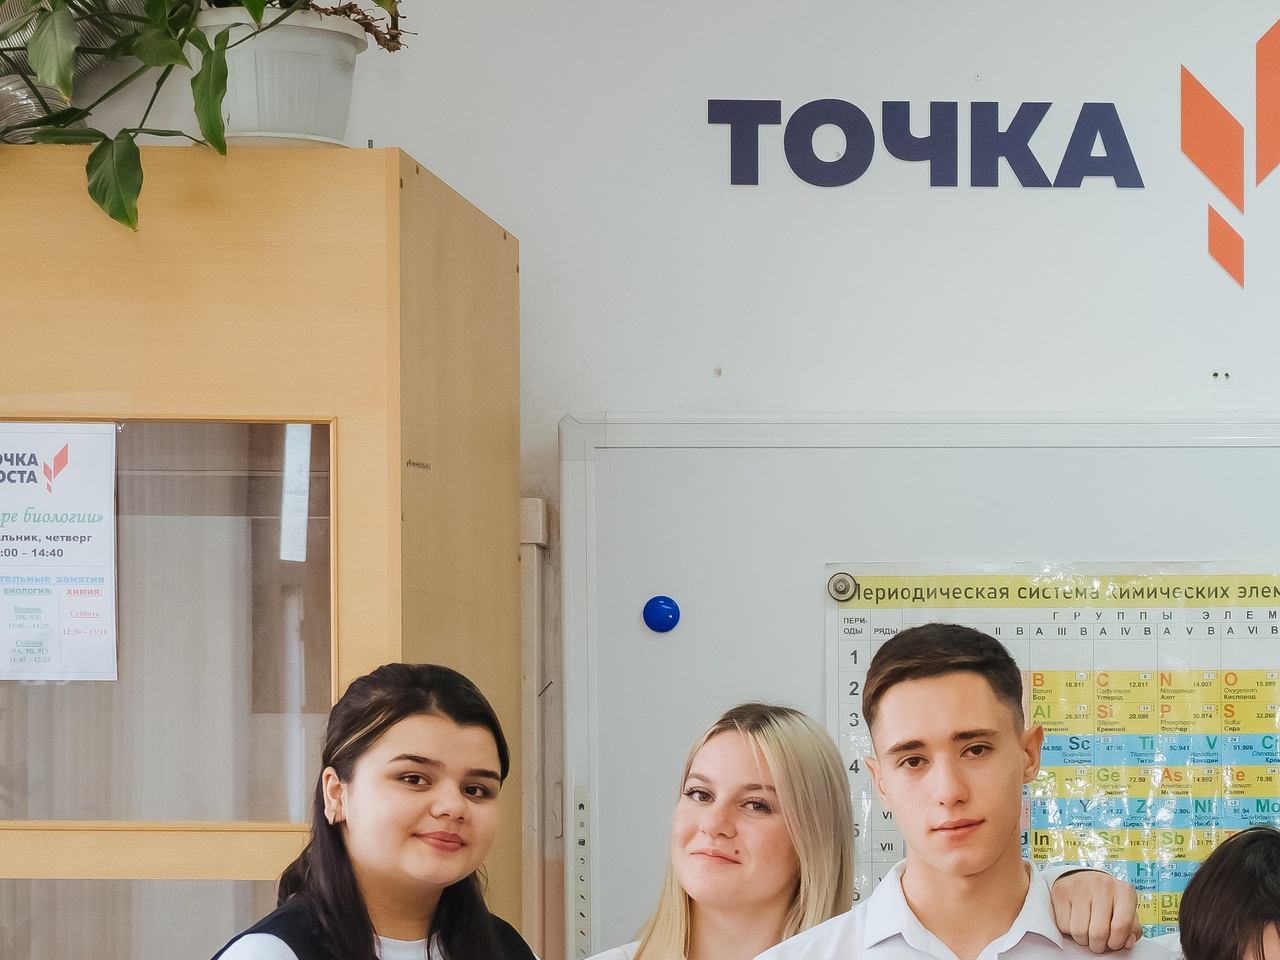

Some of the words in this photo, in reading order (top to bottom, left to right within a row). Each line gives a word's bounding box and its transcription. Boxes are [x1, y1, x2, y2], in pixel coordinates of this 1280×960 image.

[707, 98, 1146, 189] ТОЧКА
[0, 453, 39, 466] ЧКА
[23, 506, 104, 524] биологии»
[45, 535, 92, 544] четверг
[31, 548, 64, 558] 14:40
[56, 576, 105, 584] занятия
[3, 587, 53, 595] БИОЛОГИЯ:
[66, 588, 103, 597] ХИМИЯ:
[843, 617, 869, 625] ПЕРИ-
[843, 627, 863, 635] ОДЫ
[1057, 626, 1067, 636] III
[1121, 626, 1131, 636] IV
[1248, 626, 1258, 635] VI
[850, 649, 858, 664] 1
[1033, 673, 1045, 687] B
[1096, 673, 1109, 687] C
[1160, 673, 1172, 687] N
[1224, 672, 1238, 686] O
[849, 681, 859, 695] 2
[1096, 704, 1114, 719] Si
[1160, 704, 1171, 718] P
[1223, 703, 1235, 718] S
[849, 713, 860, 728] 3
[1068, 736, 1091, 750] Sc
[1138, 736, 1154, 750] Ti
[1205, 735, 1218, 749] V
[849, 759, 860, 774] 4
[1096, 767, 1120, 782] Ge
[1161, 767, 1183, 782] As
[882, 811, 893, 820] VI
[1034, 831, 1050, 846] In
[880, 842, 894, 851] VII
